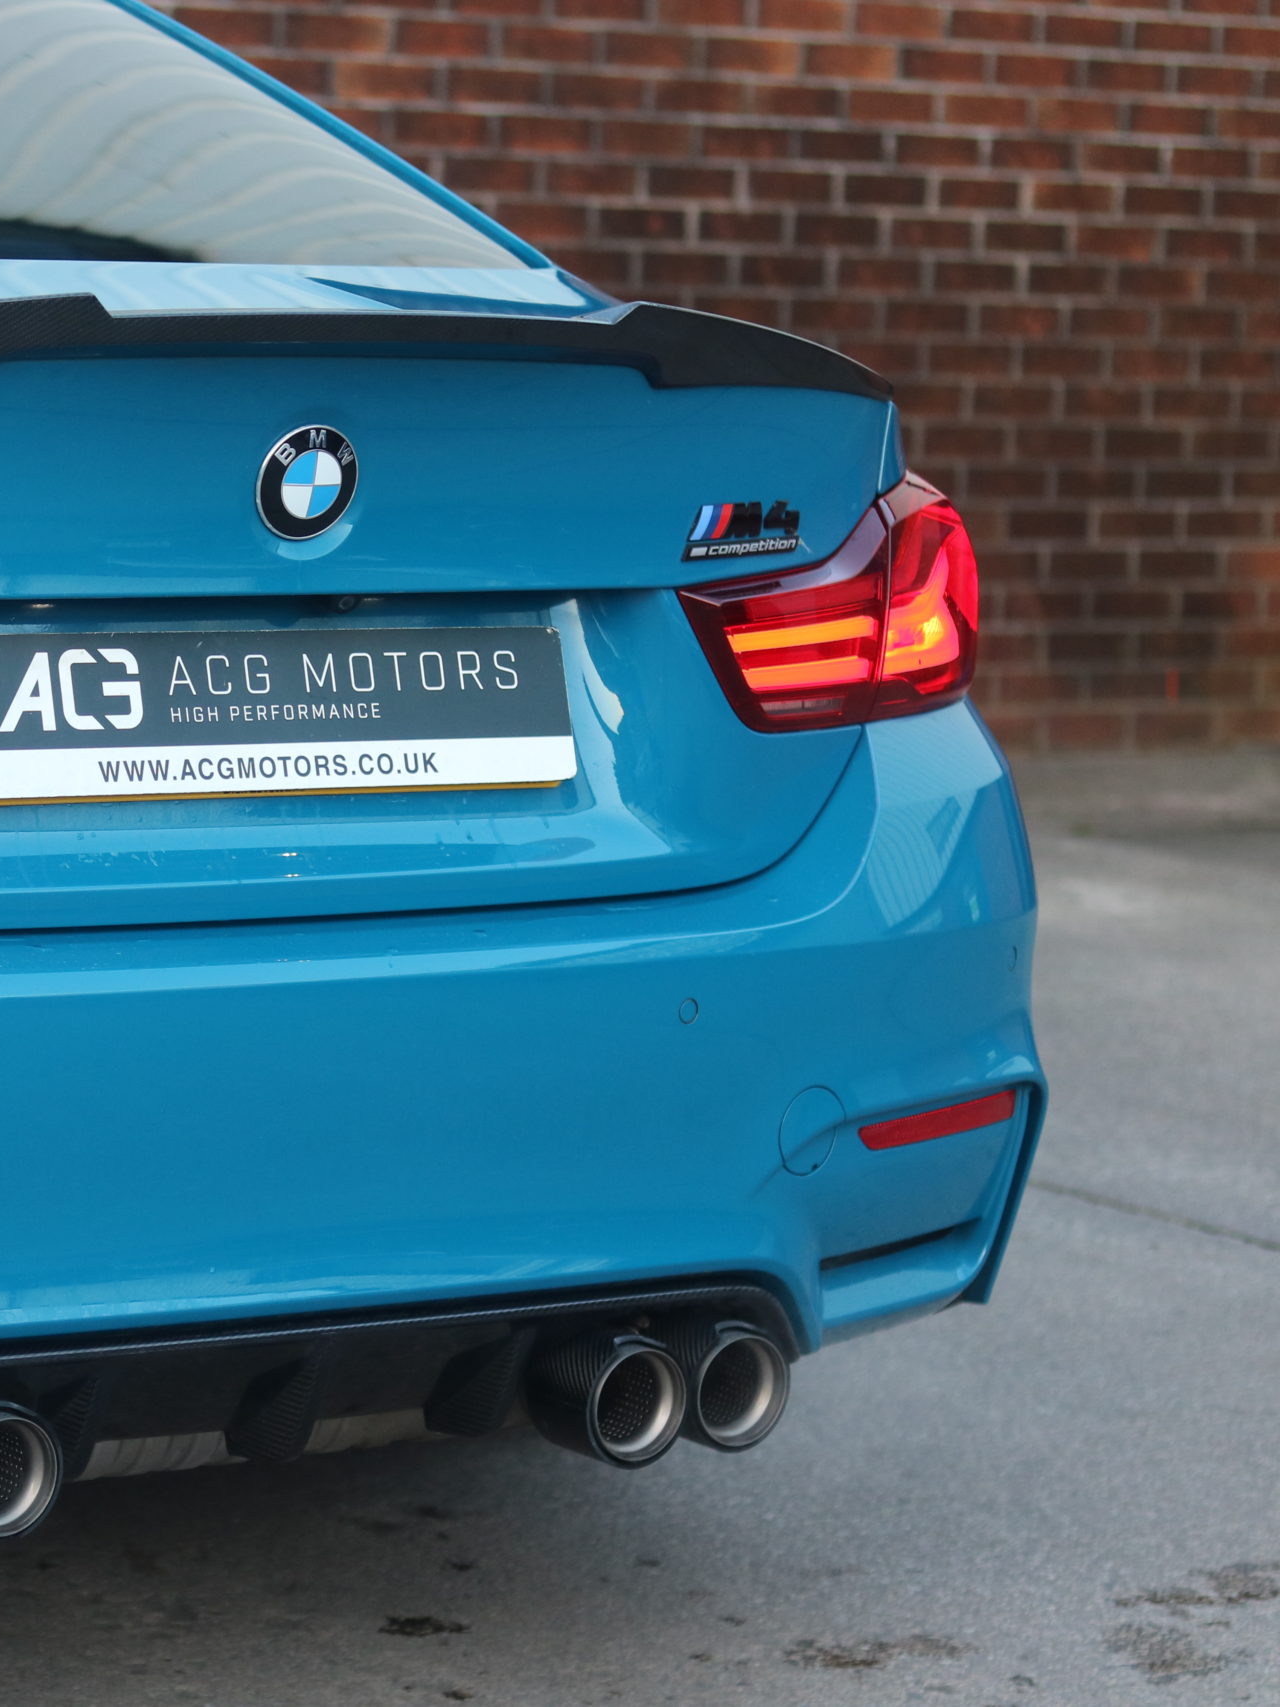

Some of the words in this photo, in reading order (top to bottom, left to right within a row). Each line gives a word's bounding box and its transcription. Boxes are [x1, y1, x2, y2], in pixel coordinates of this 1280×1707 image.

[274, 429, 354, 467] BMW
[723, 499, 800, 538] M4
[709, 538, 796, 555] competition
[0, 648, 143, 732] ACG
[169, 654, 271, 696] ACG
[302, 650, 519, 692] MOTORS
[171, 705, 219, 722] HIGH
[229, 702, 381, 721] PERFORMANCE
[99, 753, 438, 782] WWW.ACGMOTORS.CO.UK
